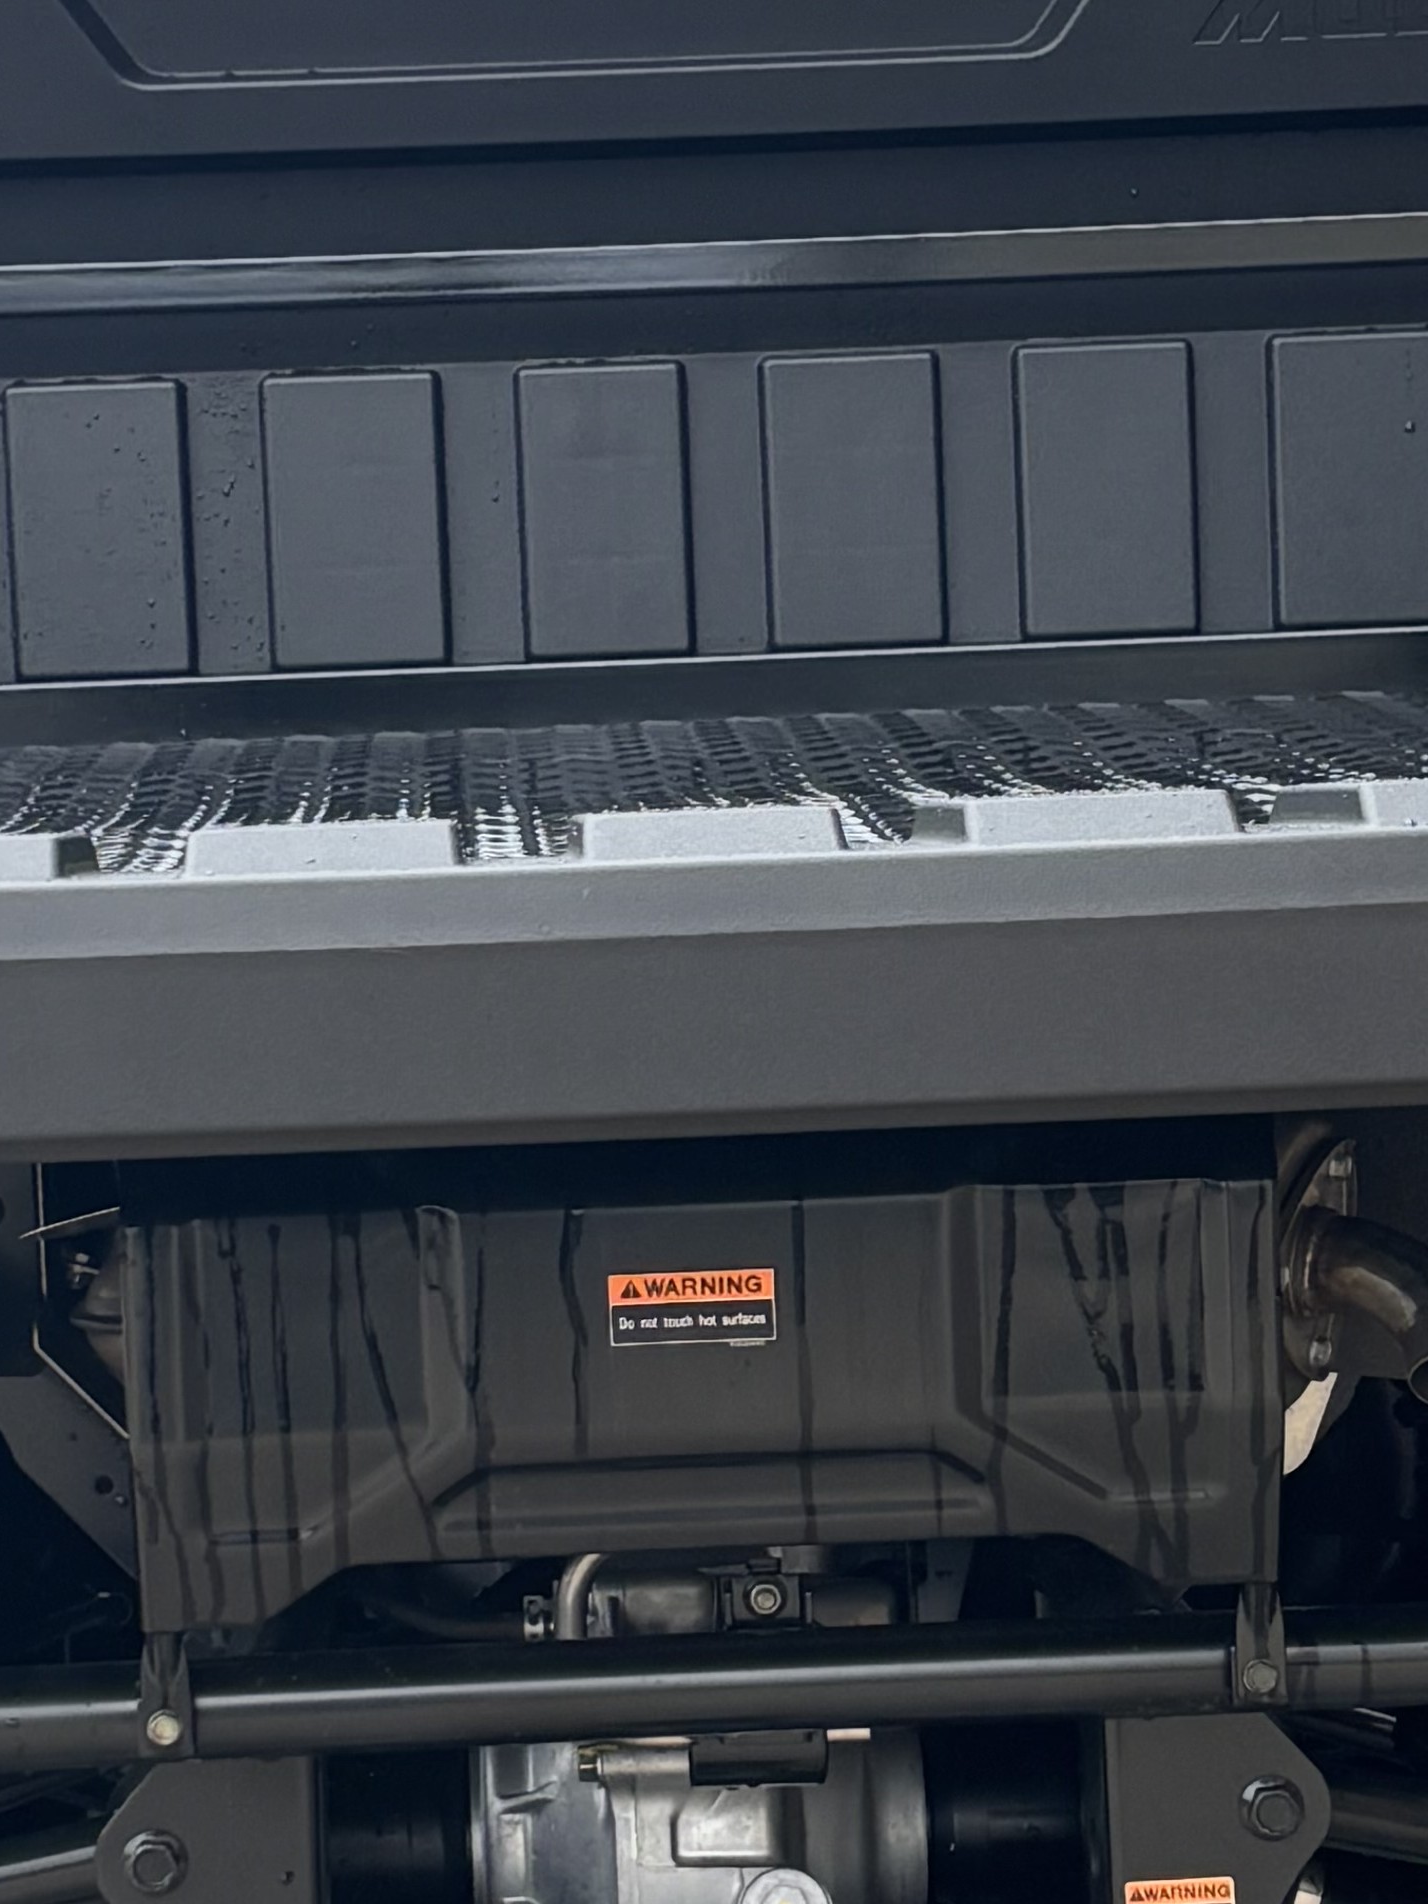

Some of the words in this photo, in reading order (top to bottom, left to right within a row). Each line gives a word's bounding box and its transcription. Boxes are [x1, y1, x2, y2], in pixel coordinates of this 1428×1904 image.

[644, 1275, 762, 1298] WARNING
[619, 1317, 635, 1330] Do
[640, 1317, 658, 1329] not
[664, 1314, 693, 1327] touch
[699, 1313, 717, 1326] hot
[722, 1312, 766, 1326] surfaces
[1144, 1884, 1231, 1901] WARNING
